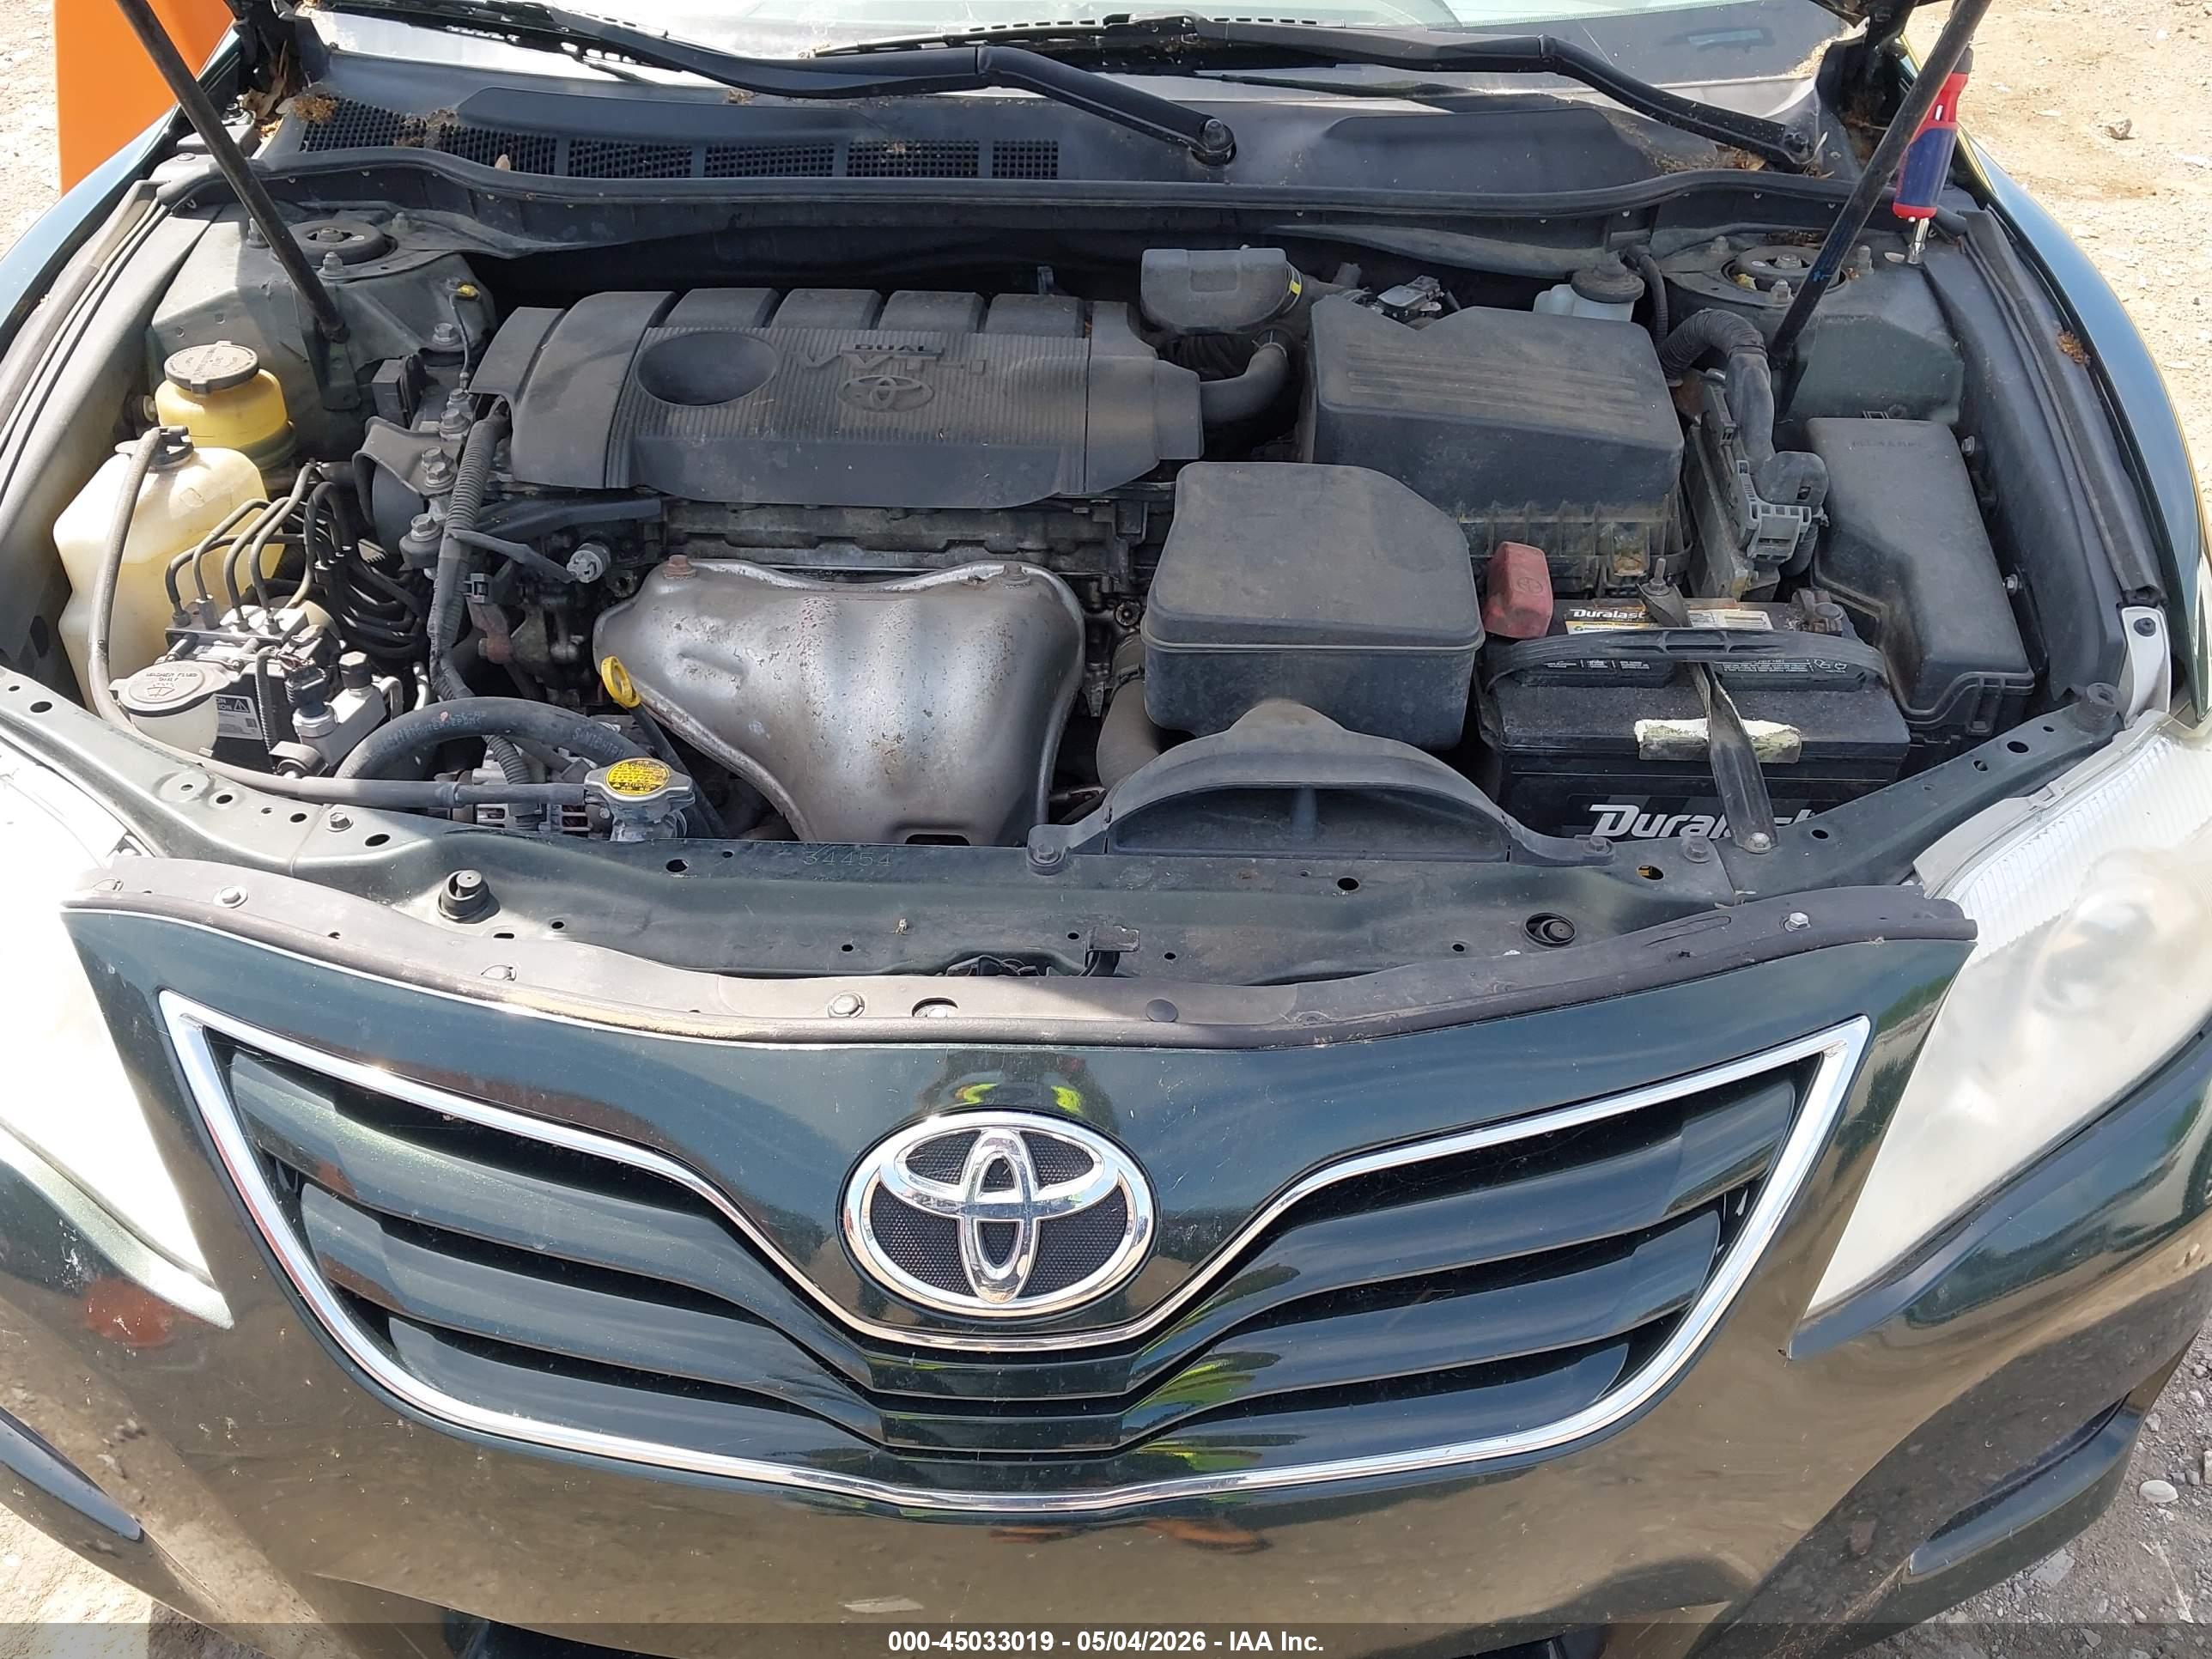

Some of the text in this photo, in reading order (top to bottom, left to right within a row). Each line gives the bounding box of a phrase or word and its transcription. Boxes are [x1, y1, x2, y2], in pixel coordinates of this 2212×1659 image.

[853, 343, 931, 353] DUAL
[1569, 608, 1646, 618] Duralast
[803, 850, 891, 867] 34454
